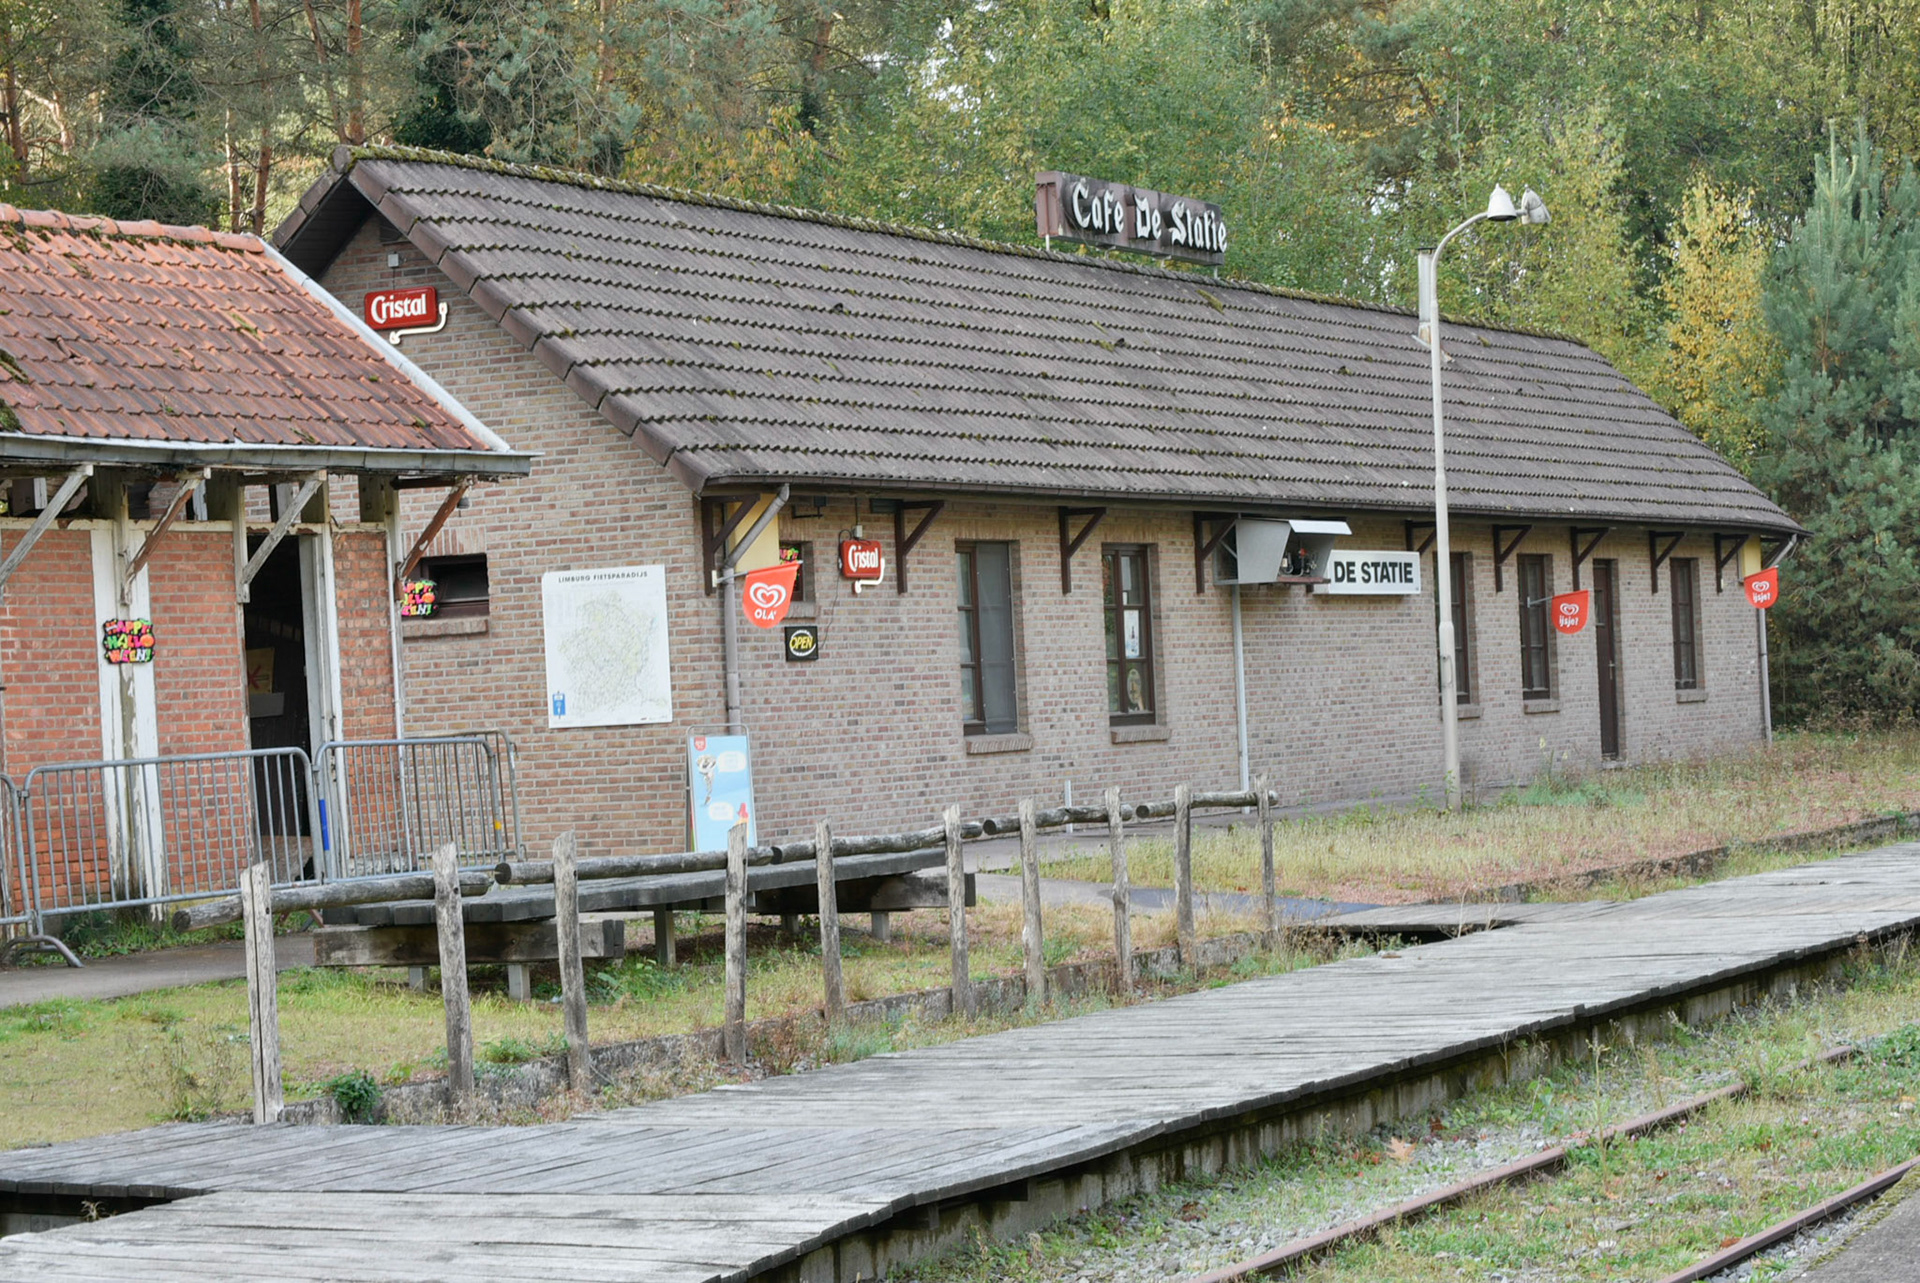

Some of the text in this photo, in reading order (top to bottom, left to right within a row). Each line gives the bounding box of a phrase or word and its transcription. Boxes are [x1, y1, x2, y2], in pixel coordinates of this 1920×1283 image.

[1134, 194, 1162, 241] De
[1169, 200, 1227, 254] Statie
[371, 293, 427, 324] Cristal
[848, 544, 879, 572] Cristal
[593, 571, 648, 581] FIETSPARADIJS
[1334, 561, 1413, 584] DE STATIE
[789, 637, 814, 650] OPEN
